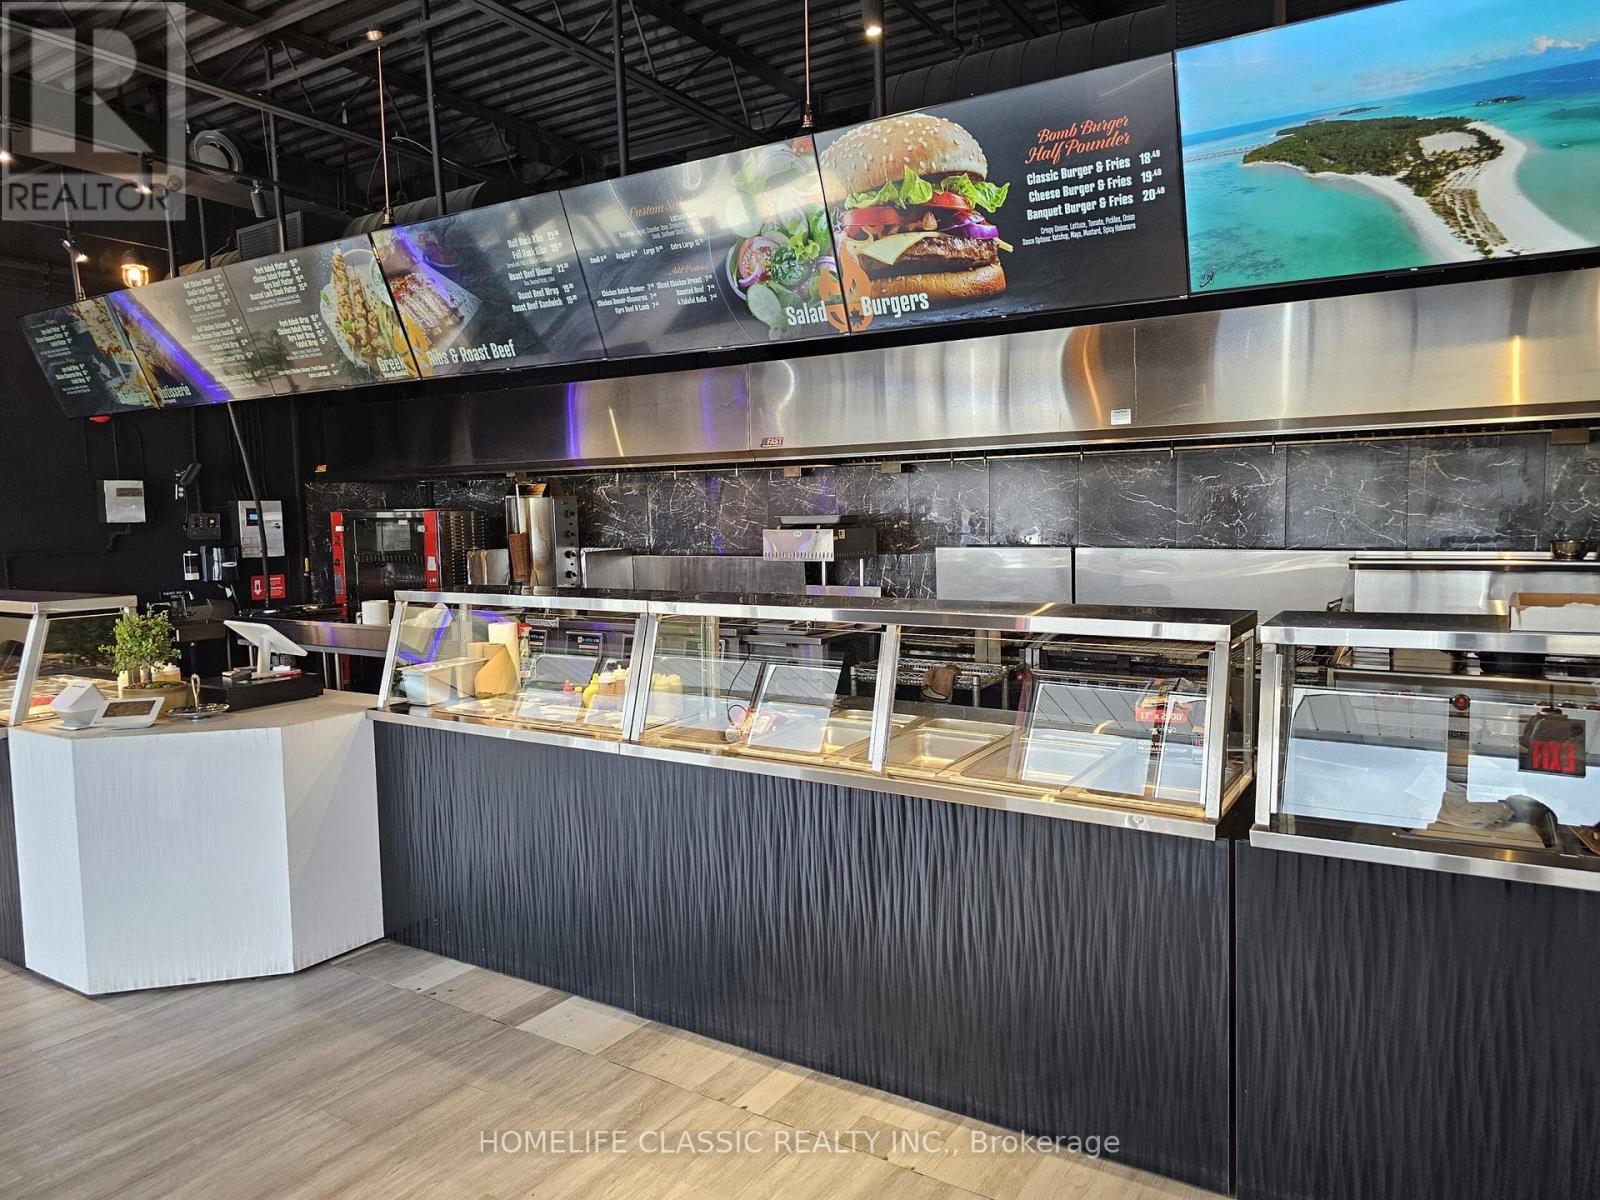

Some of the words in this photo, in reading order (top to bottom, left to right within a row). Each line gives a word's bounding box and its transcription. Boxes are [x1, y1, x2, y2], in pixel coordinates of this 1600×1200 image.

[1037, 122, 1077, 144] Bomb
[1080, 115, 1129, 137] Burger
[1024, 141, 1064, 165] Half
[1065, 132, 1131, 157] Pounder
[1026, 169, 1059, 186] Classic
[1060, 164, 1094, 179] Burger
[1096, 161, 1104, 173] &
[1105, 157, 1131, 172] Fries
[1028, 187, 1061, 203] Cheese
[1062, 182, 1096, 197] Burger
[1097, 179, 1106, 191] &
[1107, 175, 1133, 190] Fries
[1026, 204, 1063, 221] Banquet
[1064, 199, 1098, 215] Burger
[1099, 197, 1107, 209] &
[1108, 193, 1134, 208] Fries
[523, 269, 535, 279] Beef
[526, 301, 539, 311] Beef
[532, 288, 545, 298] Beef
[860, 292, 930, 319] Burgers
[785, 300, 828, 326] Salad
[377, 353, 407, 372] Greek
[426, 350, 450, 366] Ribs
[450, 349, 459, 364] &
[459, 346, 491, 363] Roast
[489, 339, 517, 359] Beef
